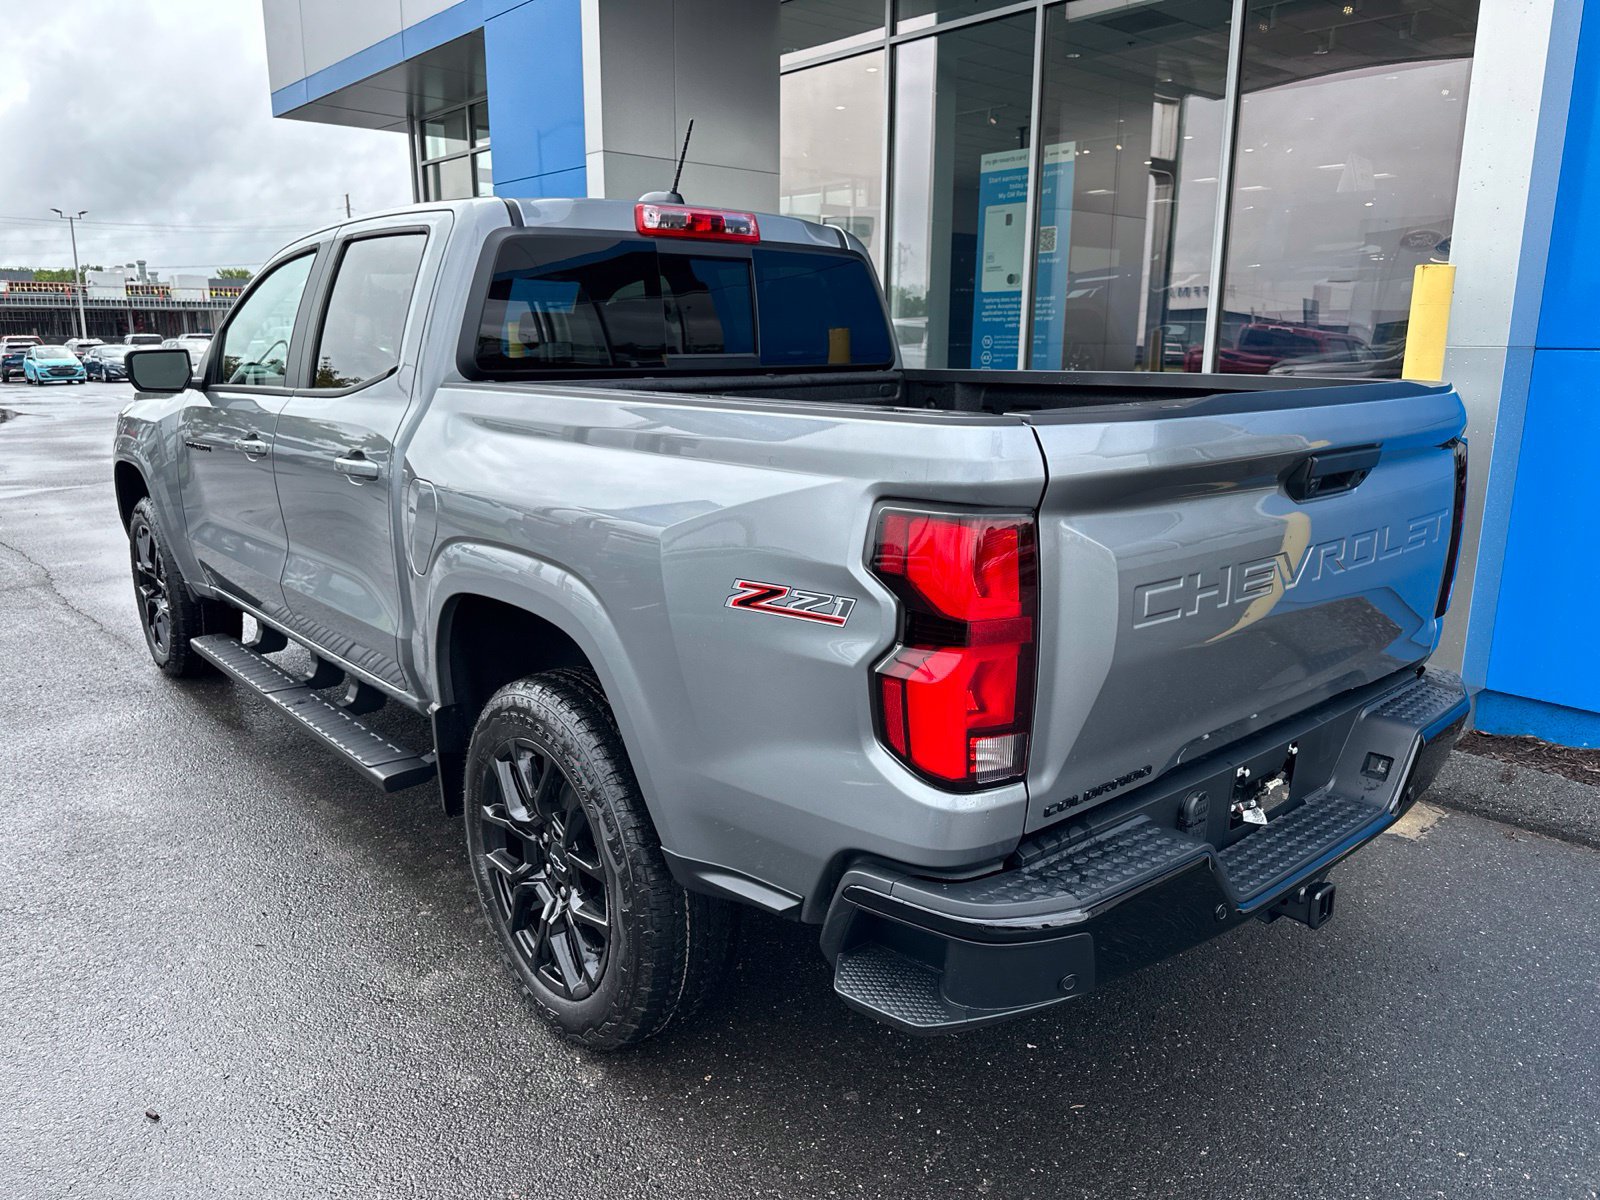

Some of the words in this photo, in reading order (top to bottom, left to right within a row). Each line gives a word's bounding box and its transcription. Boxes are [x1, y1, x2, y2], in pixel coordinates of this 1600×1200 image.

[1133, 508, 1448, 629] CHEVROLET
[724, 578, 857, 628] Z71
[1043, 764, 1153, 818] COLORADO
